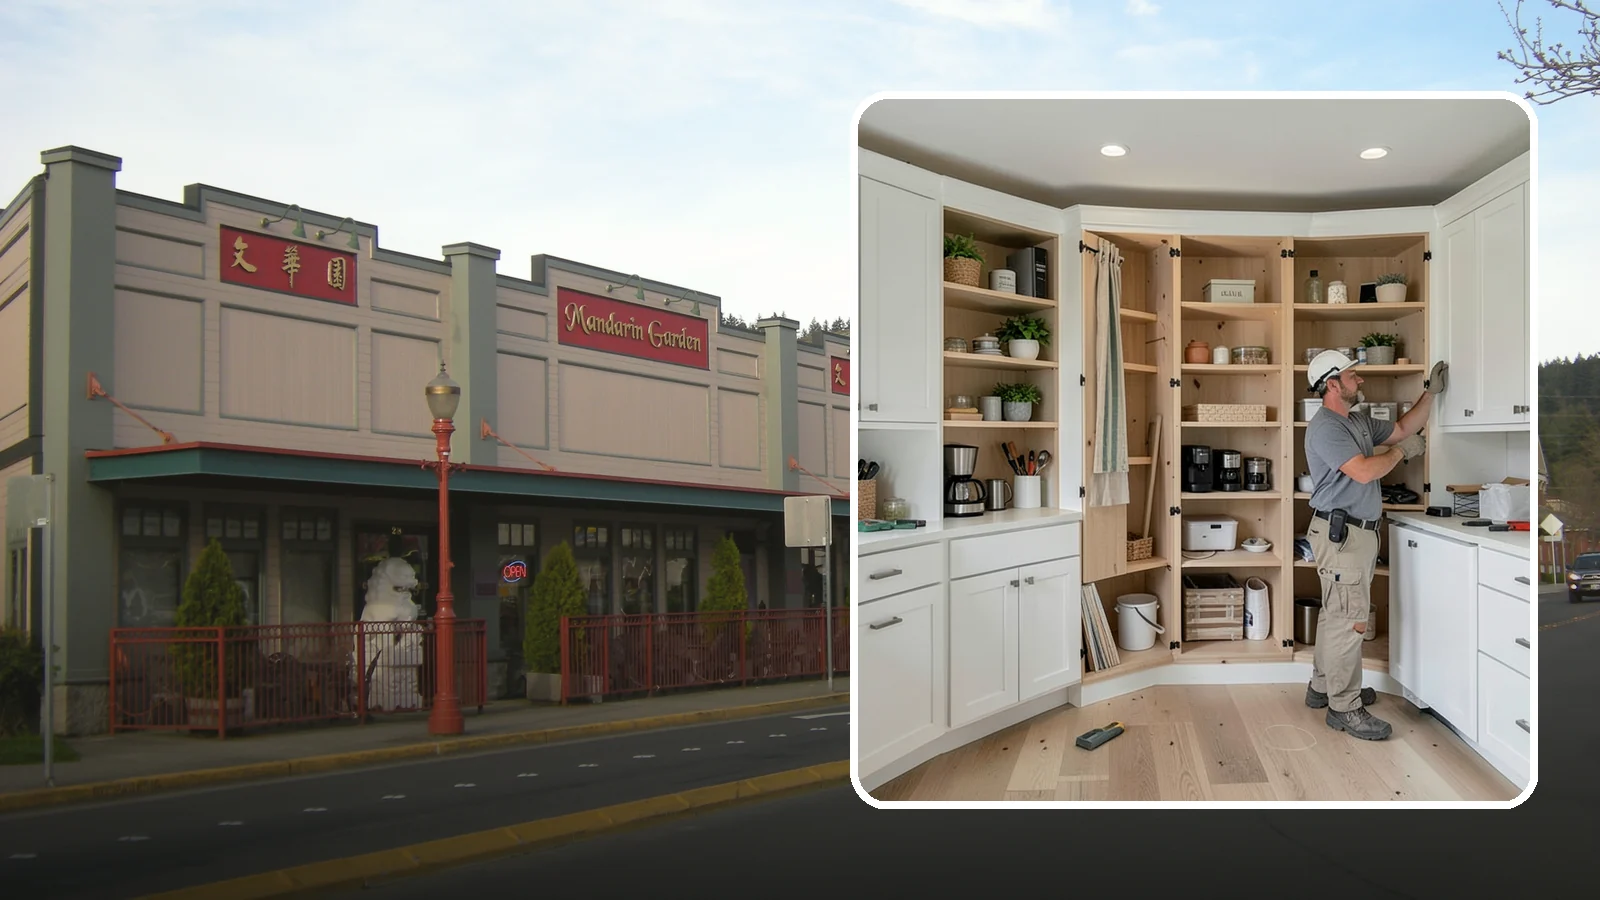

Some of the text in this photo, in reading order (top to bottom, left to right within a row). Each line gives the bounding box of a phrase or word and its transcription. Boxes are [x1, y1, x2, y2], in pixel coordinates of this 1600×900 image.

[231, 235, 346, 291] 文華園
[564, 302, 702, 352] Mandarin Garden
[503, 565, 527, 578] OPEN
